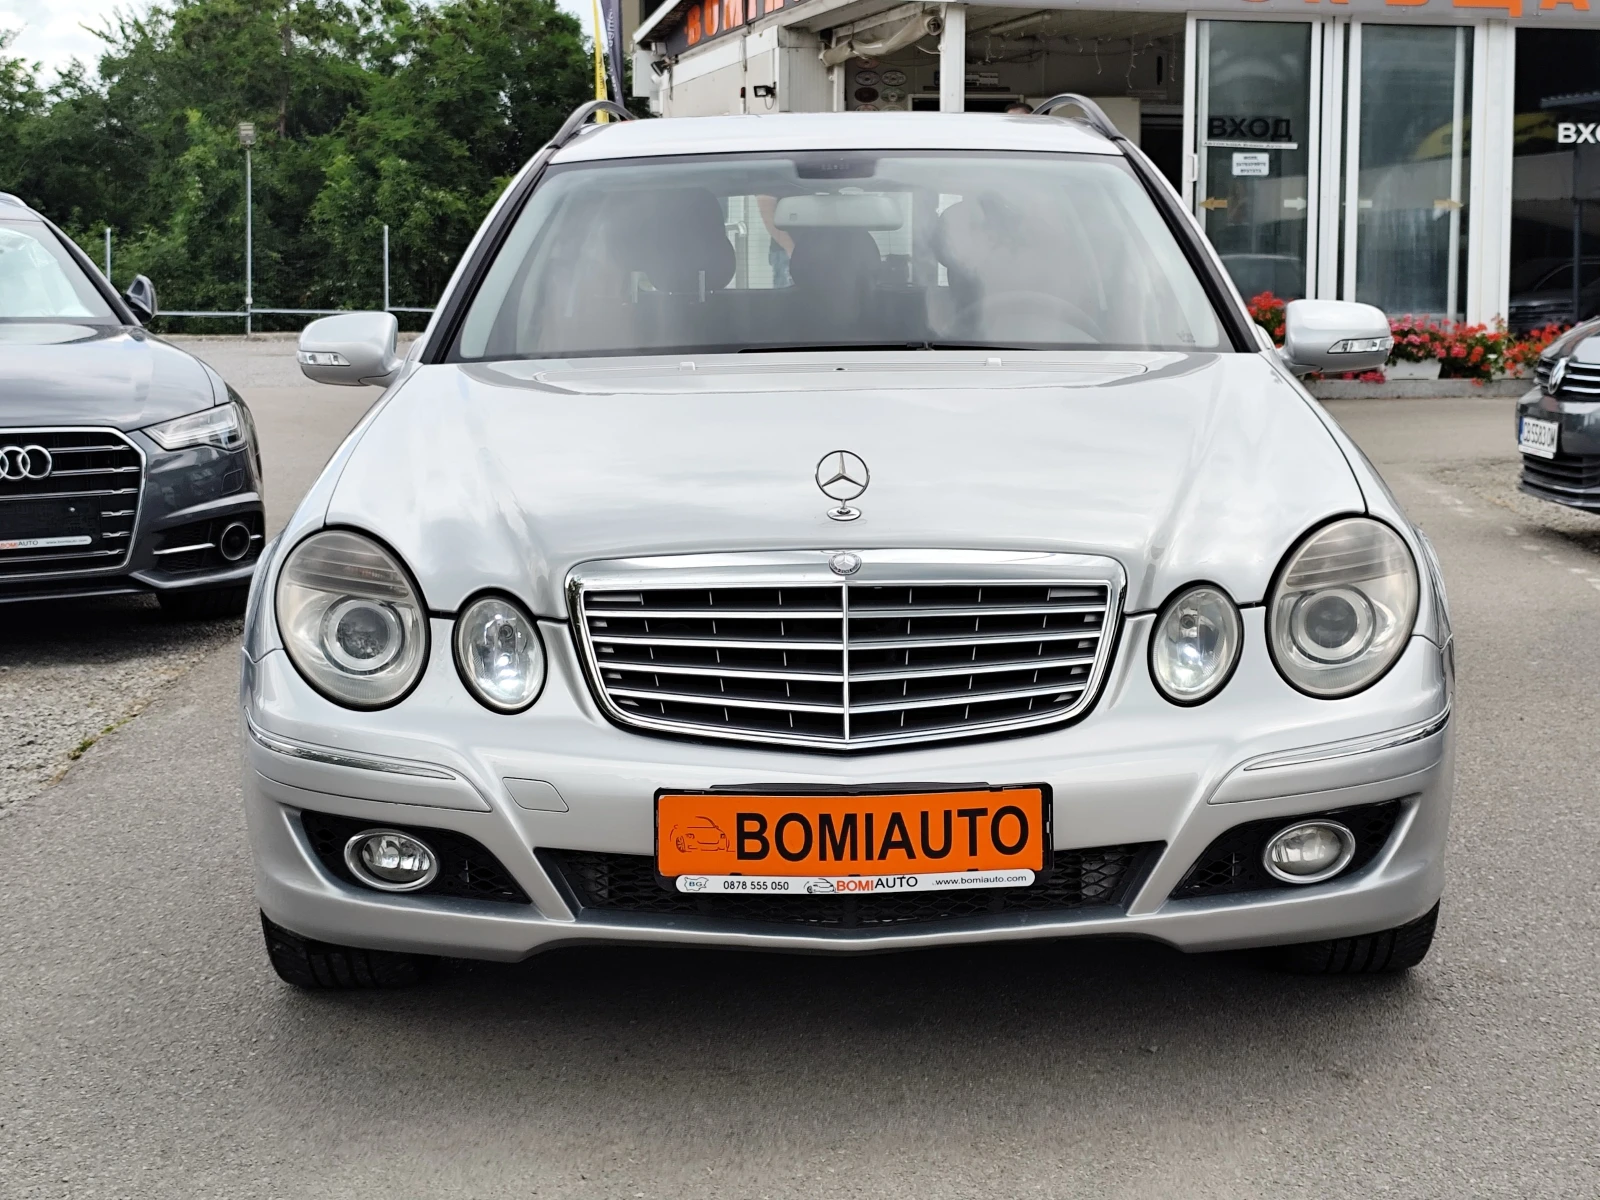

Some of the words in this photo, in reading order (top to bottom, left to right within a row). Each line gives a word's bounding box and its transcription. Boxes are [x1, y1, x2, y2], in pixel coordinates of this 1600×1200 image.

[1207, 117, 1292, 141] ВХОД
[1557, 122, 1600, 144] ВХ
[735, 805, 1029, 862] BOMIAUTO
[723, 880, 747, 890] 0878
[750, 881, 768, 890] 555
[771, 881, 789, 891] 050
[836, 876, 918, 891] BOMIAUTO
[935, 874, 1027, 886] www.bomiauto.com
